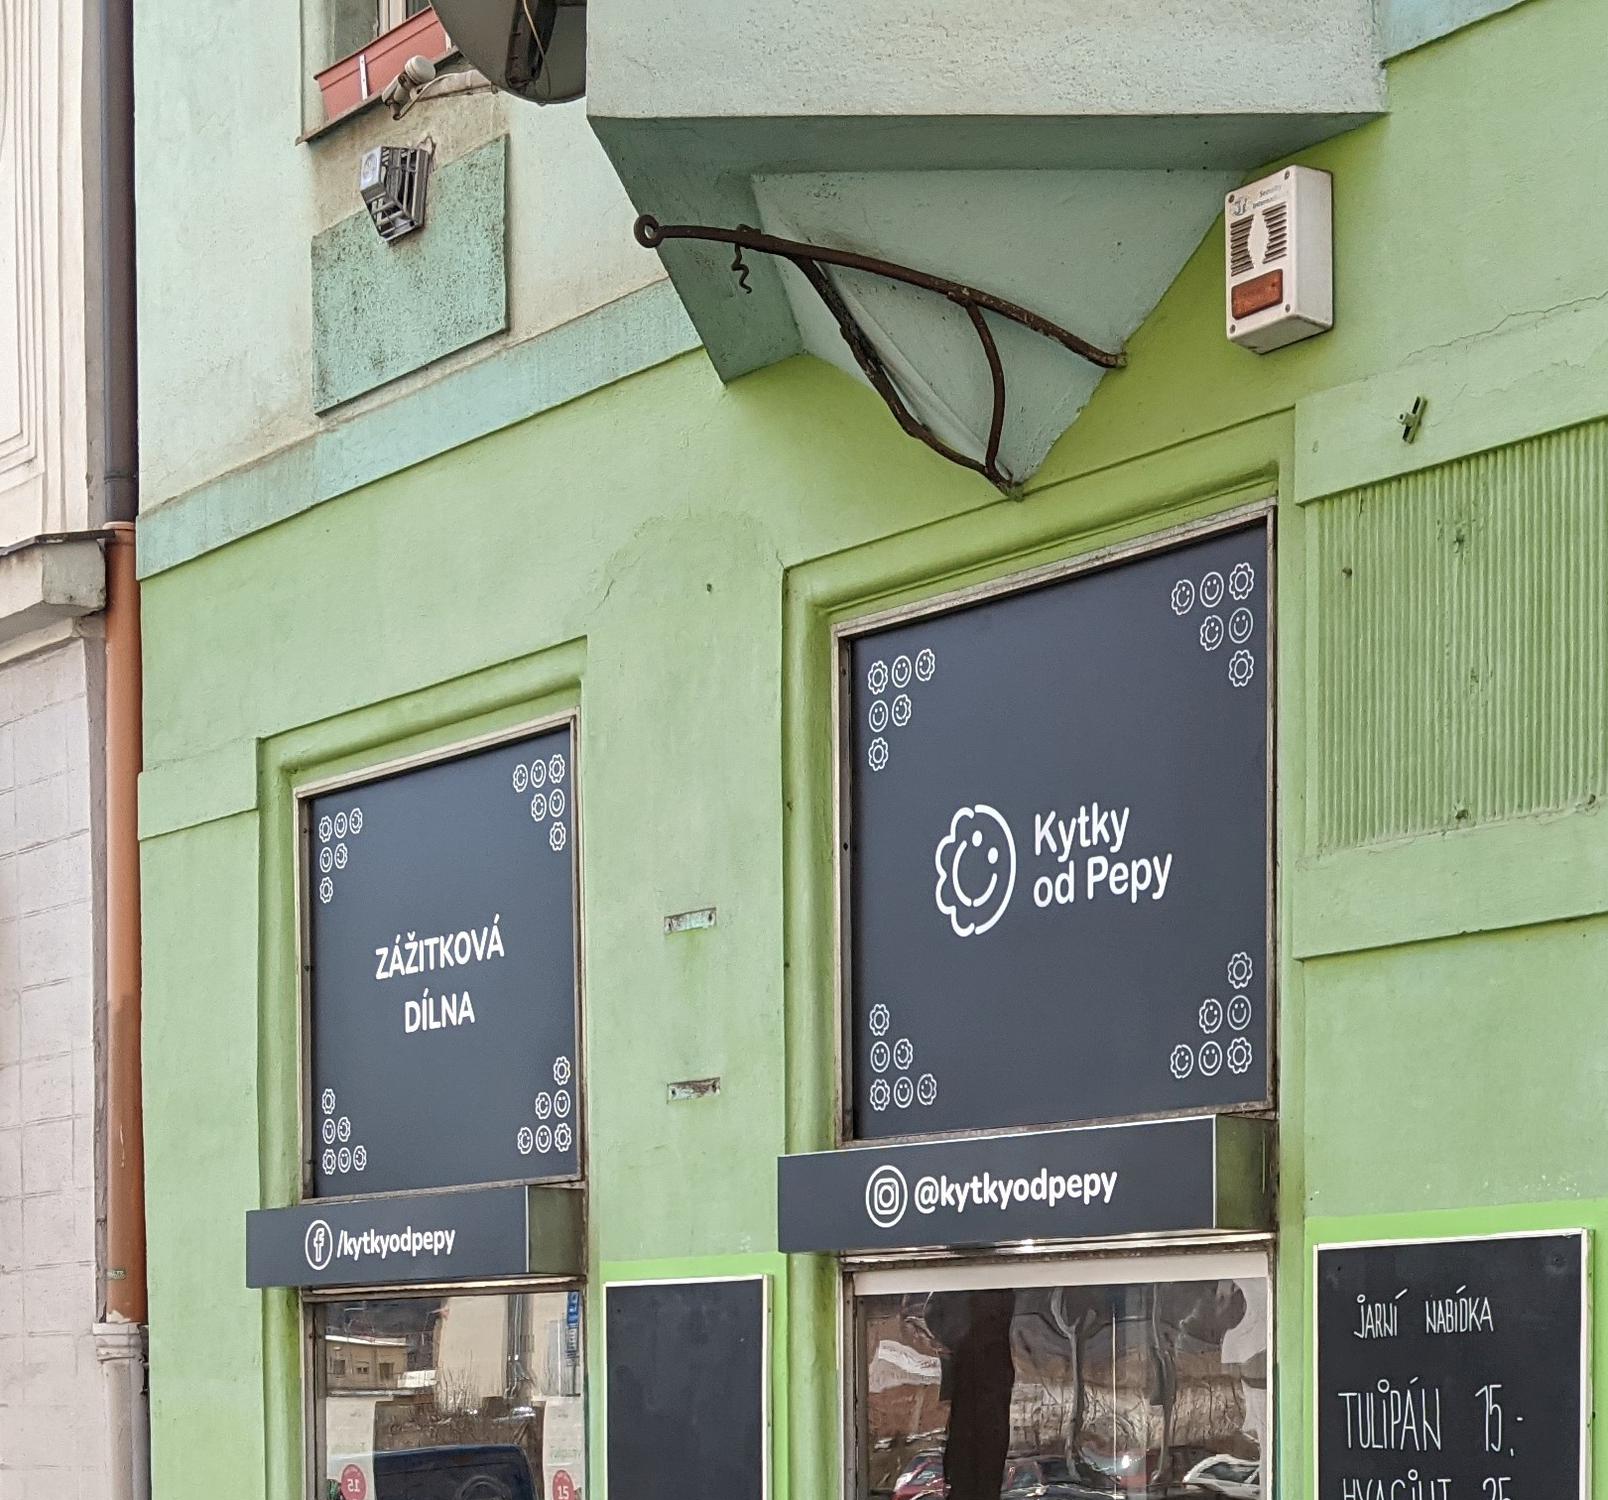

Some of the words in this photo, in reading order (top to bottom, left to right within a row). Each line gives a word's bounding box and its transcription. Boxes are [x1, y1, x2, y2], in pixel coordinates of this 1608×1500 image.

[1033, 802, 1130, 865] Kytky
[1033, 861, 1075, 908] od
[1087, 853, 1173, 903] Pepy
[375, 913, 505, 981] ZÁŽITKOVÁ
[403, 989, 475, 1033] DÍLNA
[914, 1167, 1118, 1215] @kytkyodpepy
[336, 1226, 456, 1259] /kytkyodpepy
[1353, 1288, 1408, 1340] JARNÍ
[1425, 1285, 1494, 1335] NABÍDKA
[1338, 1377, 1442, 1452] TULIPÁN
[556, 1485, 570, 1499] 15
